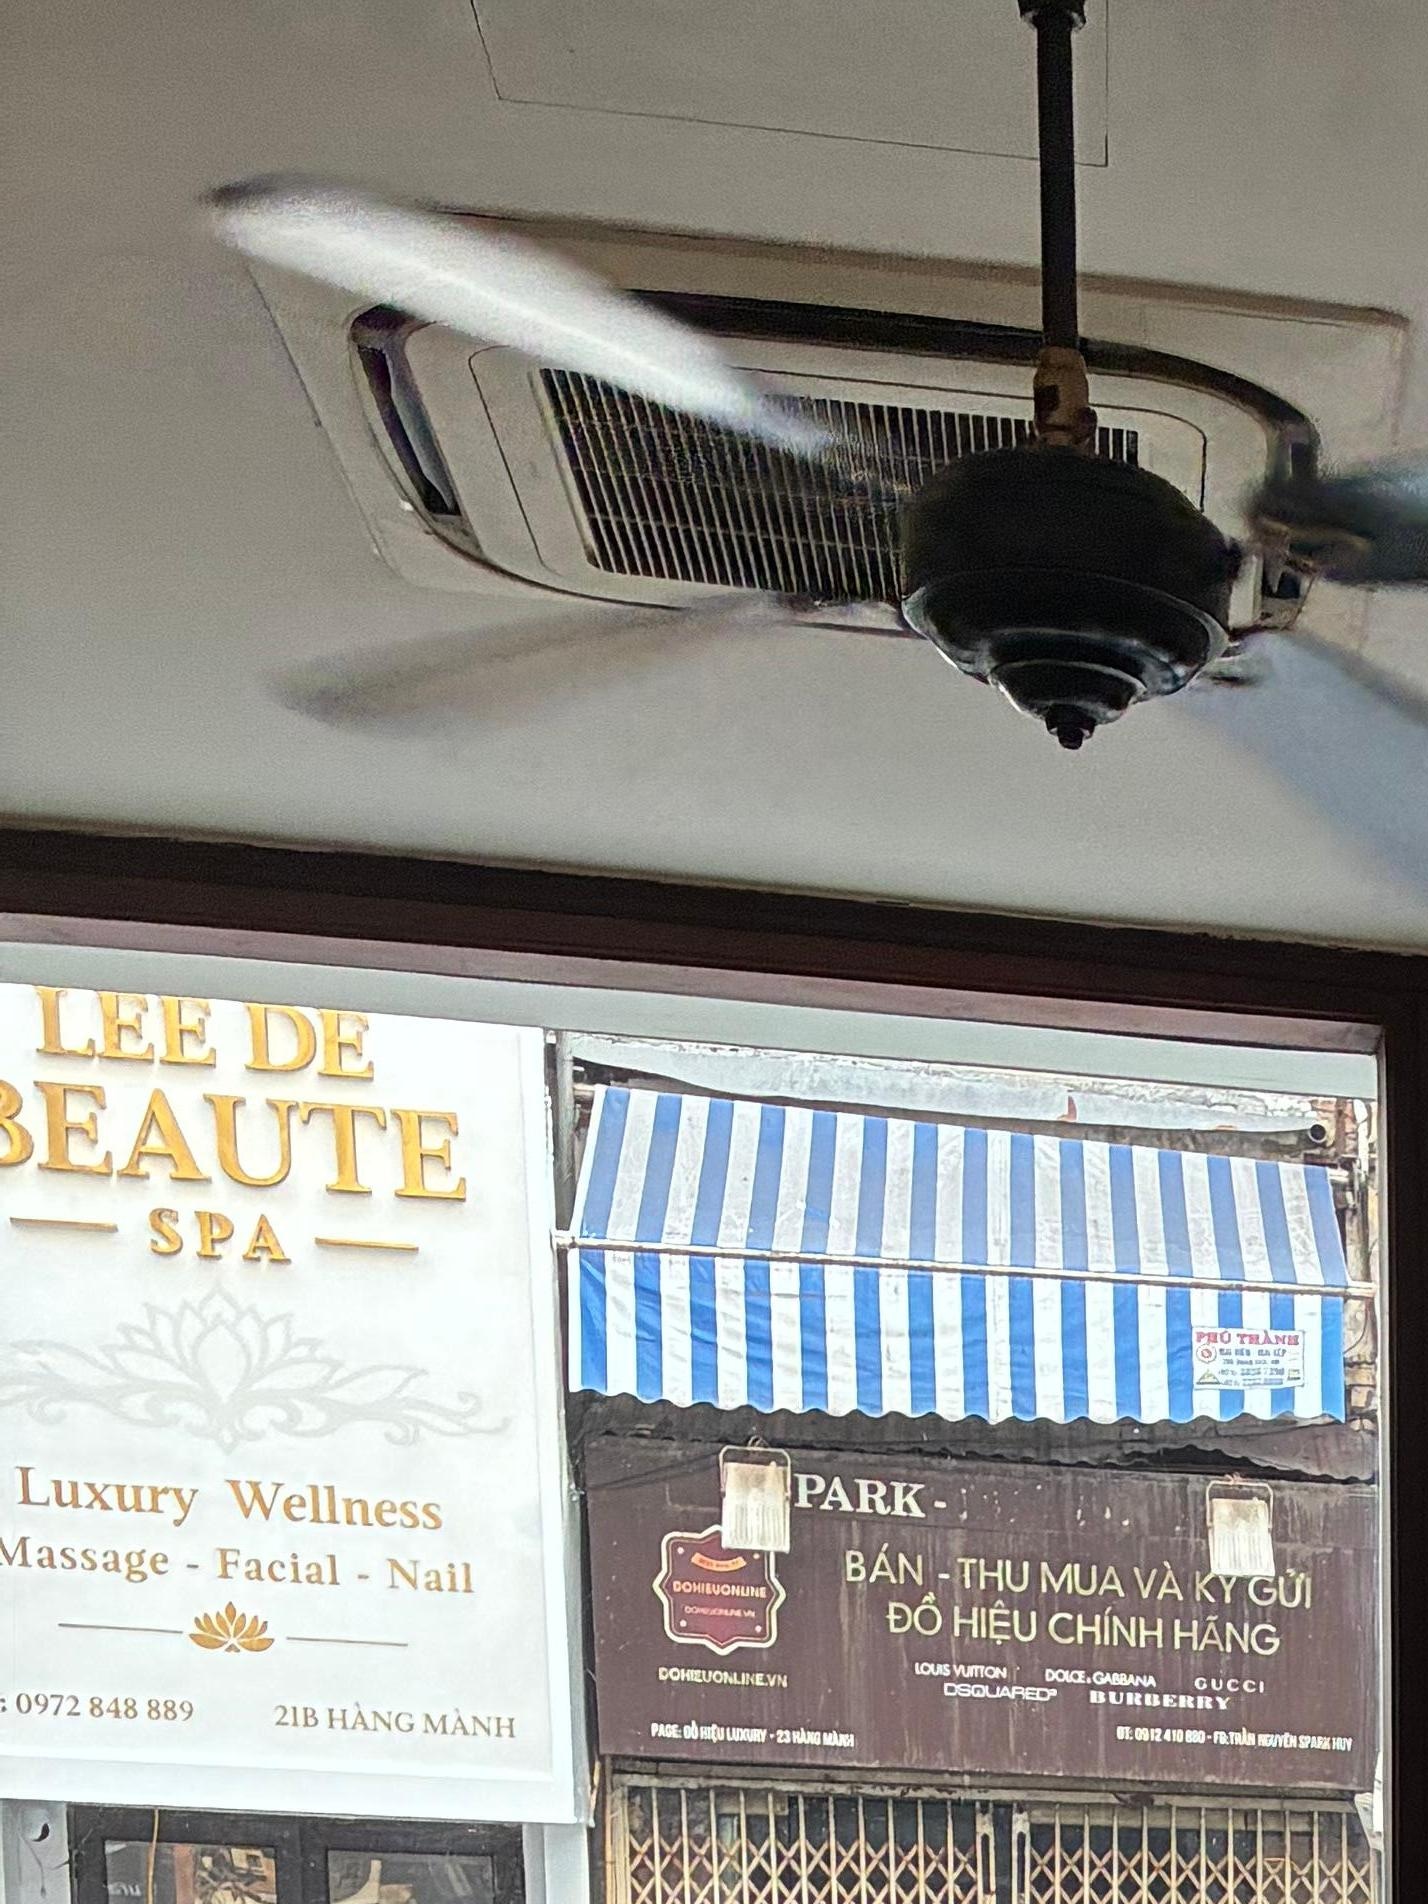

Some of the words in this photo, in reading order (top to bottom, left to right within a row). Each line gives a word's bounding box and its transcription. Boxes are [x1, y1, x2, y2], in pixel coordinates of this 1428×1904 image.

[36, 986, 216, 1067] LEE
[245, 1003, 375, 1079] DE
[147, 1208, 291, 1264] SPA
[15, 1465, 199, 1528] Luxury
[225, 1479, 444, 1531] Wellness
[0, 1535, 170, 1583] Massage
[216, 1548, 341, 1586] Facial
[388, 1558, 475, 1595] Nail
[845, 1543, 923, 1586] BÁN
[957, 1557, 1030, 1593] THU
[1041, 1563, 1125, 1598] MUA
[1134, 1560, 1183, 1601] VÀ
[1247, 1568, 1312, 1609] GỬI
[887, 1594, 943, 1636] ĐỒ
[953, 1599, 1038, 1644] HIỆU
[1047, 1607, 1164, 1650] CHÍNH
[1173, 1615, 1280, 1656] HÃNG
[914, 1662, 950, 1677] LOUIS
[954, 1664, 1007, 1679] VUITTON
[1194, 1677, 1265, 1693] GUCCI
[15, 1692, 81, 1716] 0972
[89, 1696, 138, 1719] 848
[147, 1698, 194, 1722] 889
[274, 1704, 319, 1729] 21B
[328, 1702, 415, 1734] HÀNG
[422, 1707, 517, 1738] MÀNH
[1090, 1691, 1231, 1711] BURBERRY
[726, 1726, 767, 1743] LUXURY
